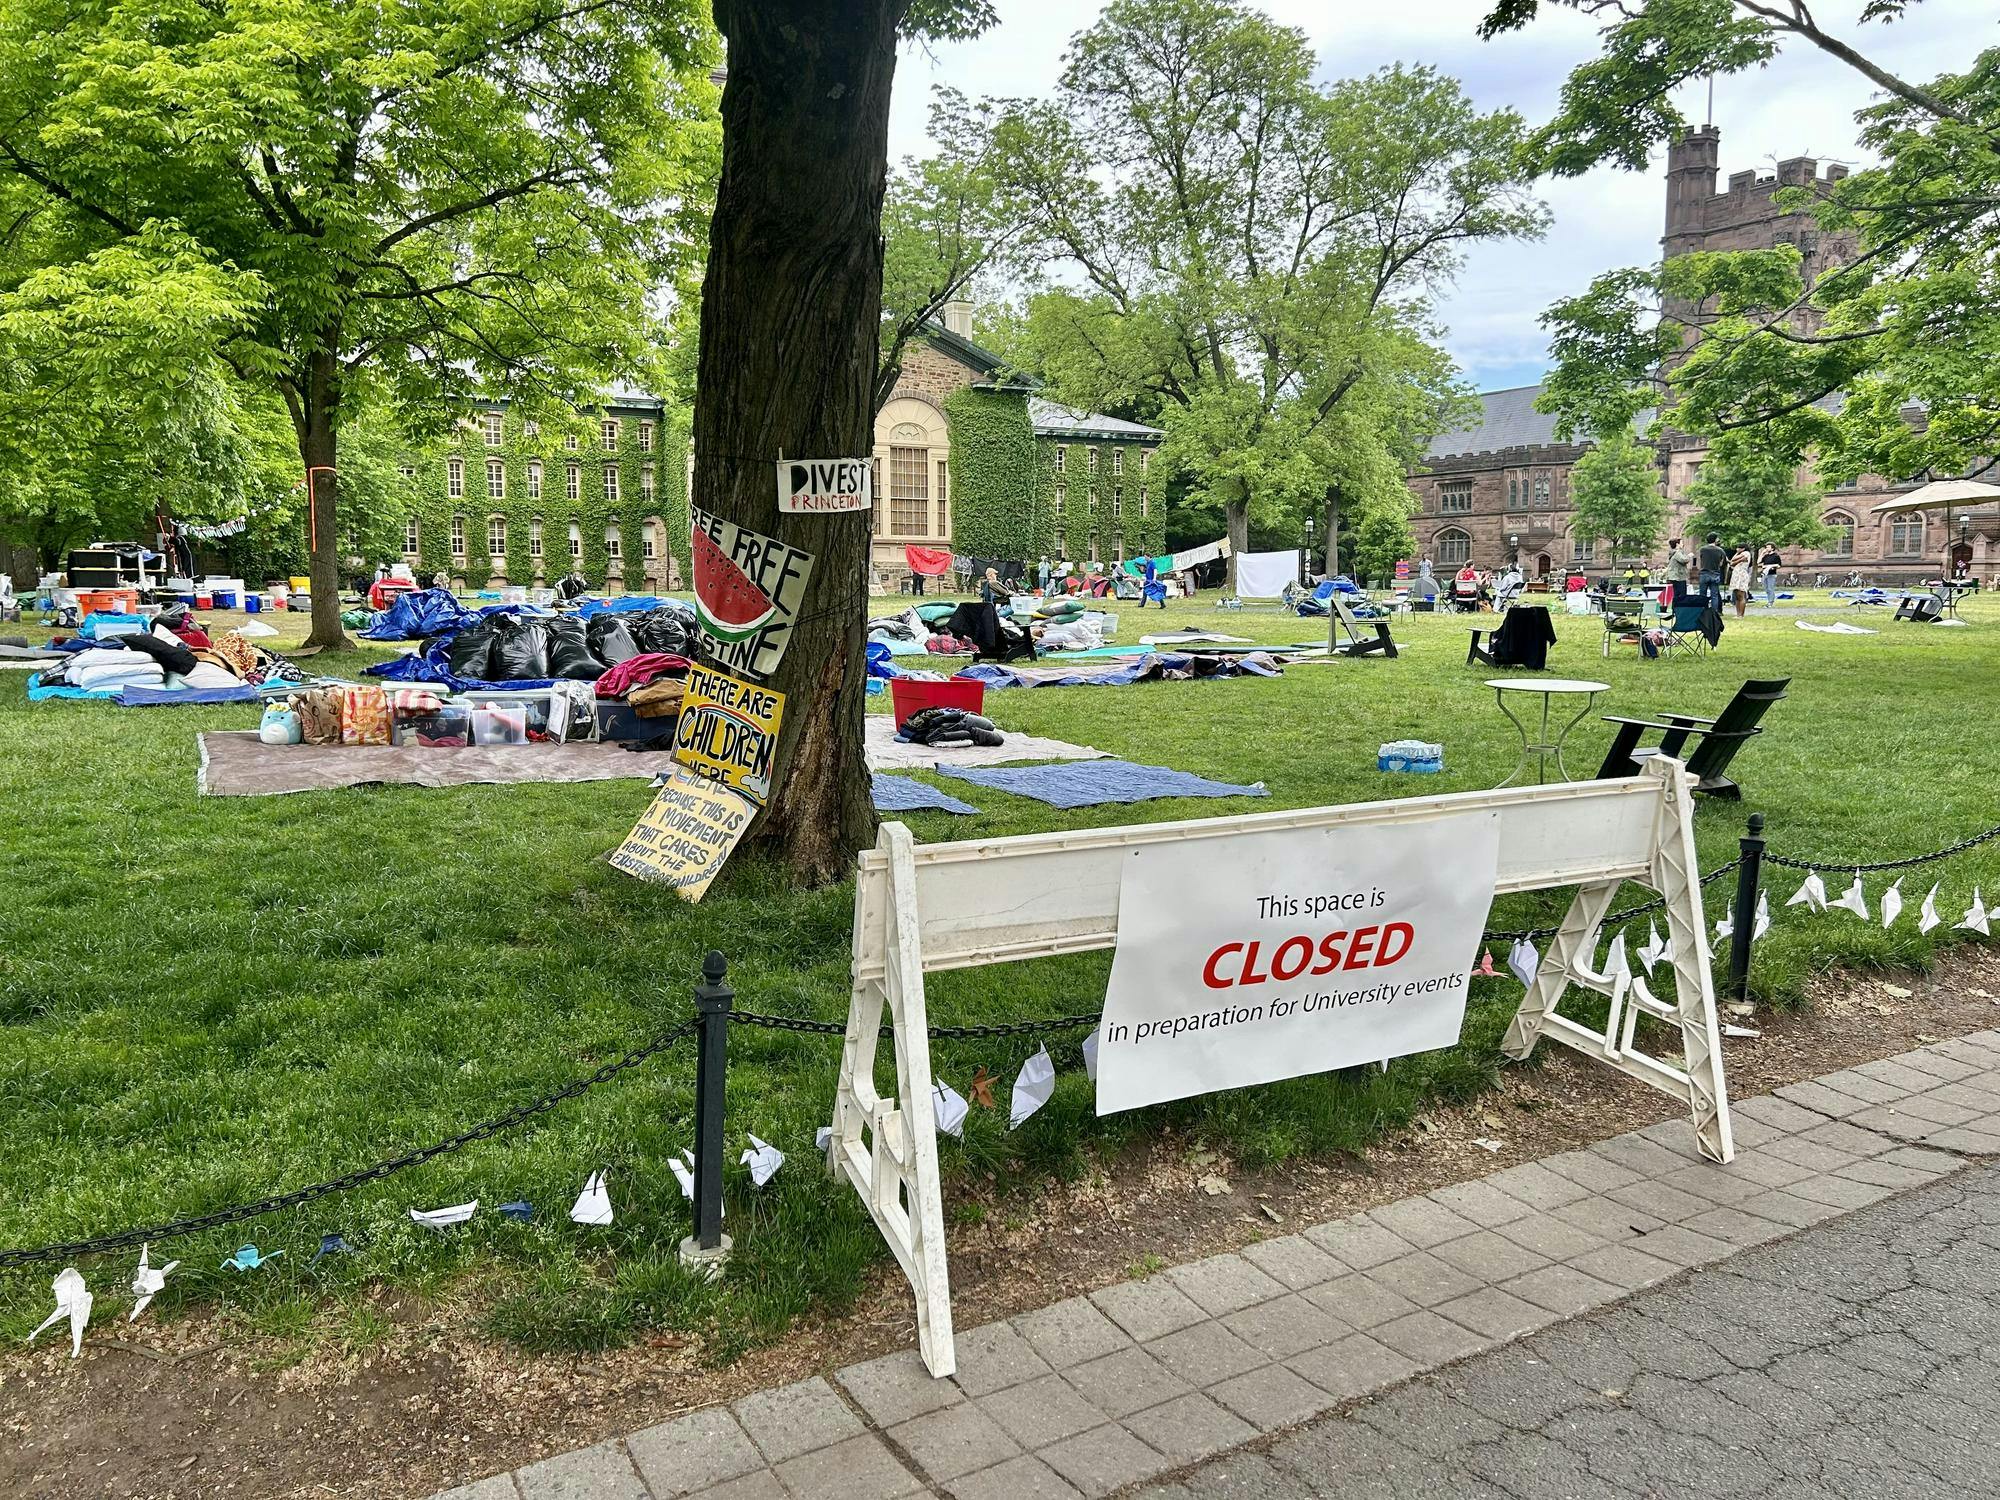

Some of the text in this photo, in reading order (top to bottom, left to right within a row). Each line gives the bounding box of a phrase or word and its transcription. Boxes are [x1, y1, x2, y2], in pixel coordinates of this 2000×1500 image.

[790, 463, 867, 495] DIVEST
[791, 494, 862, 510] PRINCETON
[691, 506, 809, 617] REE FREE
[698, 622, 788, 680] STINE
[690, 669, 778, 720] THERE ARE
[677, 705, 776, 778] CHILDREN
[644, 803, 734, 849] A MOVEMENT
[658, 787, 744, 831] BECAUSE THIS IS
[621, 840, 687, 871] ABOUT THE
[632, 823, 710, 866] THAT CARES
[1257, 886, 1386, 919] This space is
[1202, 921, 1415, 989] CLOSED
[1107, 972, 1464, 1044] in preparation for University events
